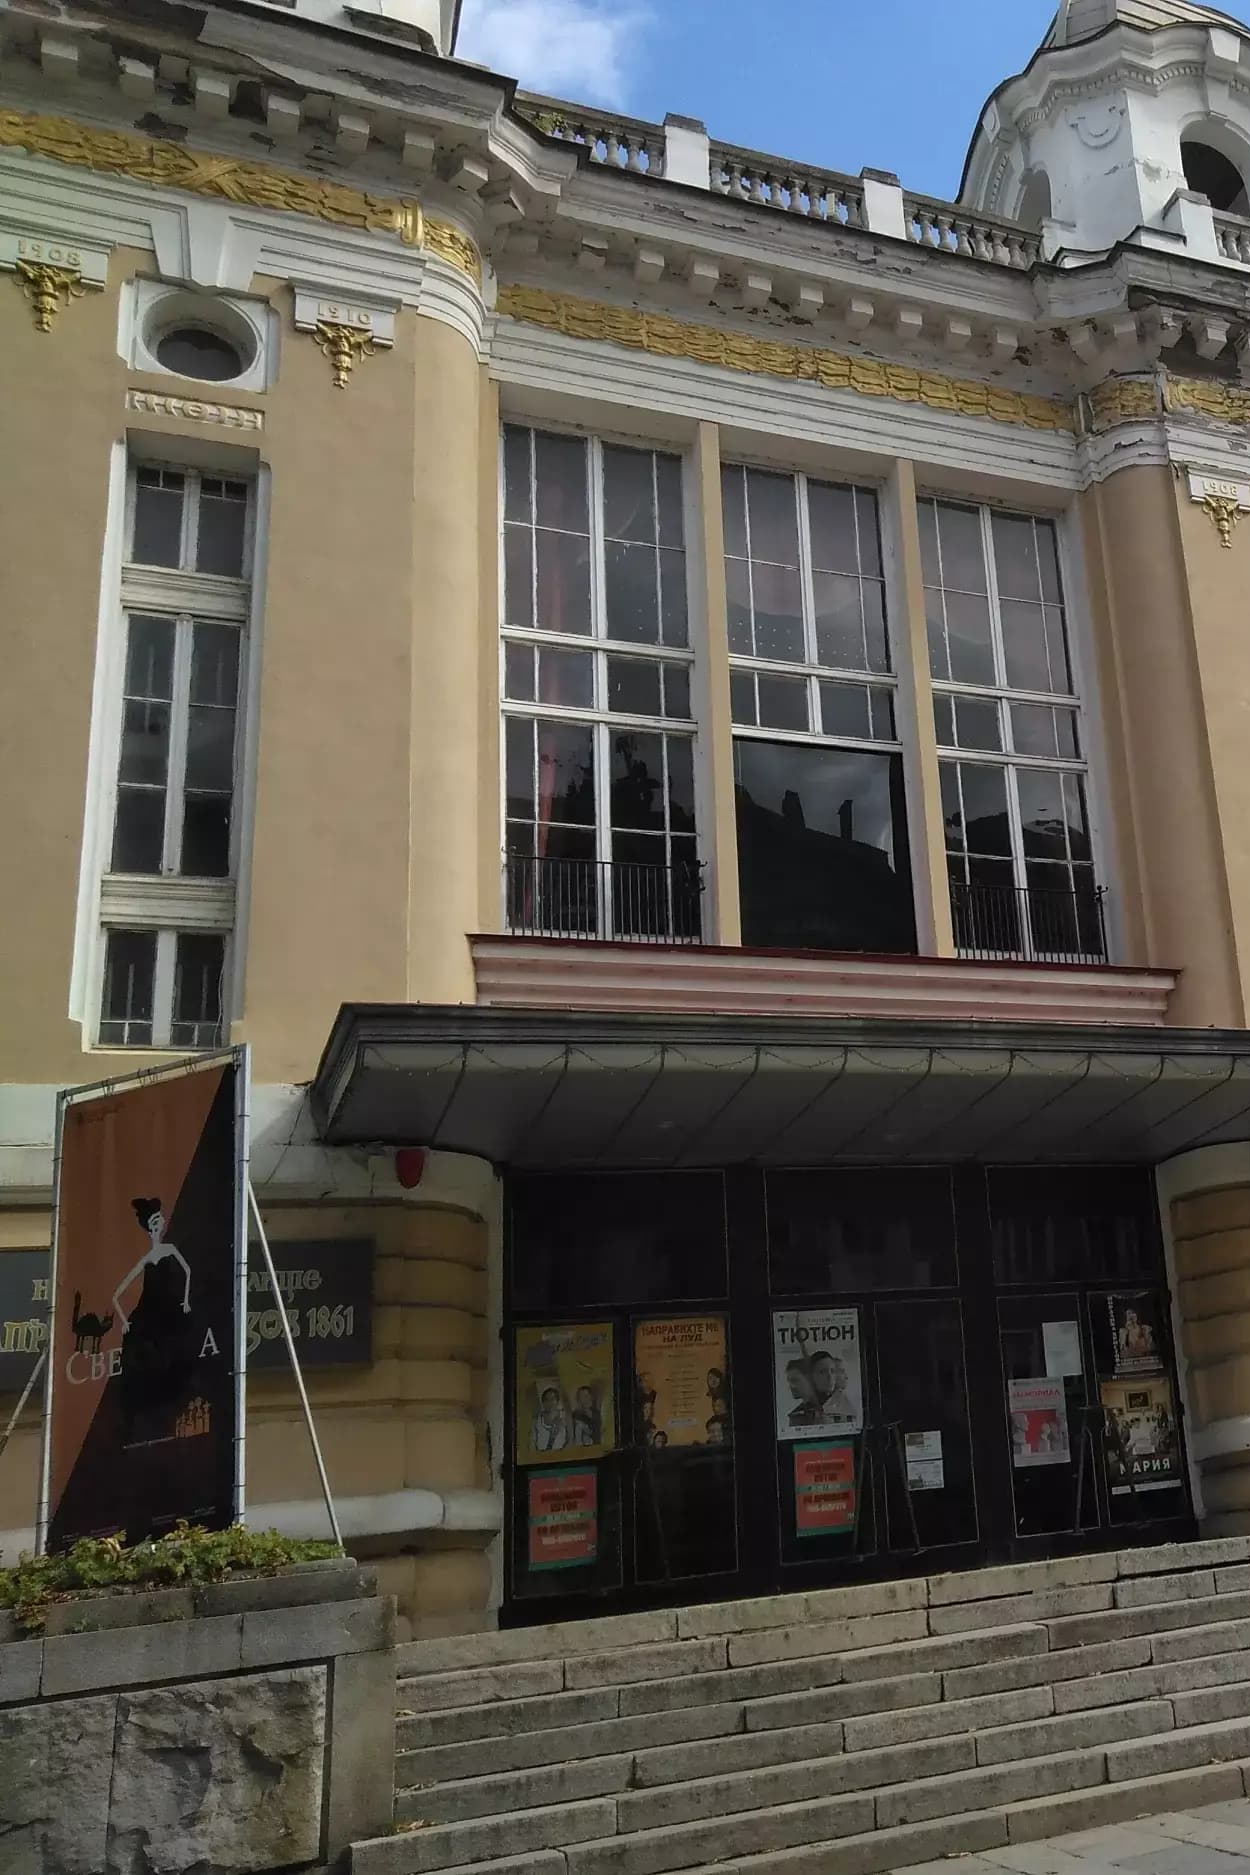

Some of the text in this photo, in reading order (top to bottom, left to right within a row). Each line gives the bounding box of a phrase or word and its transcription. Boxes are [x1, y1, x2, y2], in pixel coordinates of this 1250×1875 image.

[17, 238, 81, 266] 1908
[317, 301, 373, 327] 1910
[1203, 479, 1239, 497] 1908
[306, 1304, 355, 1339] 1861
[777, 1324, 855, 1345] ТЮТЮН
